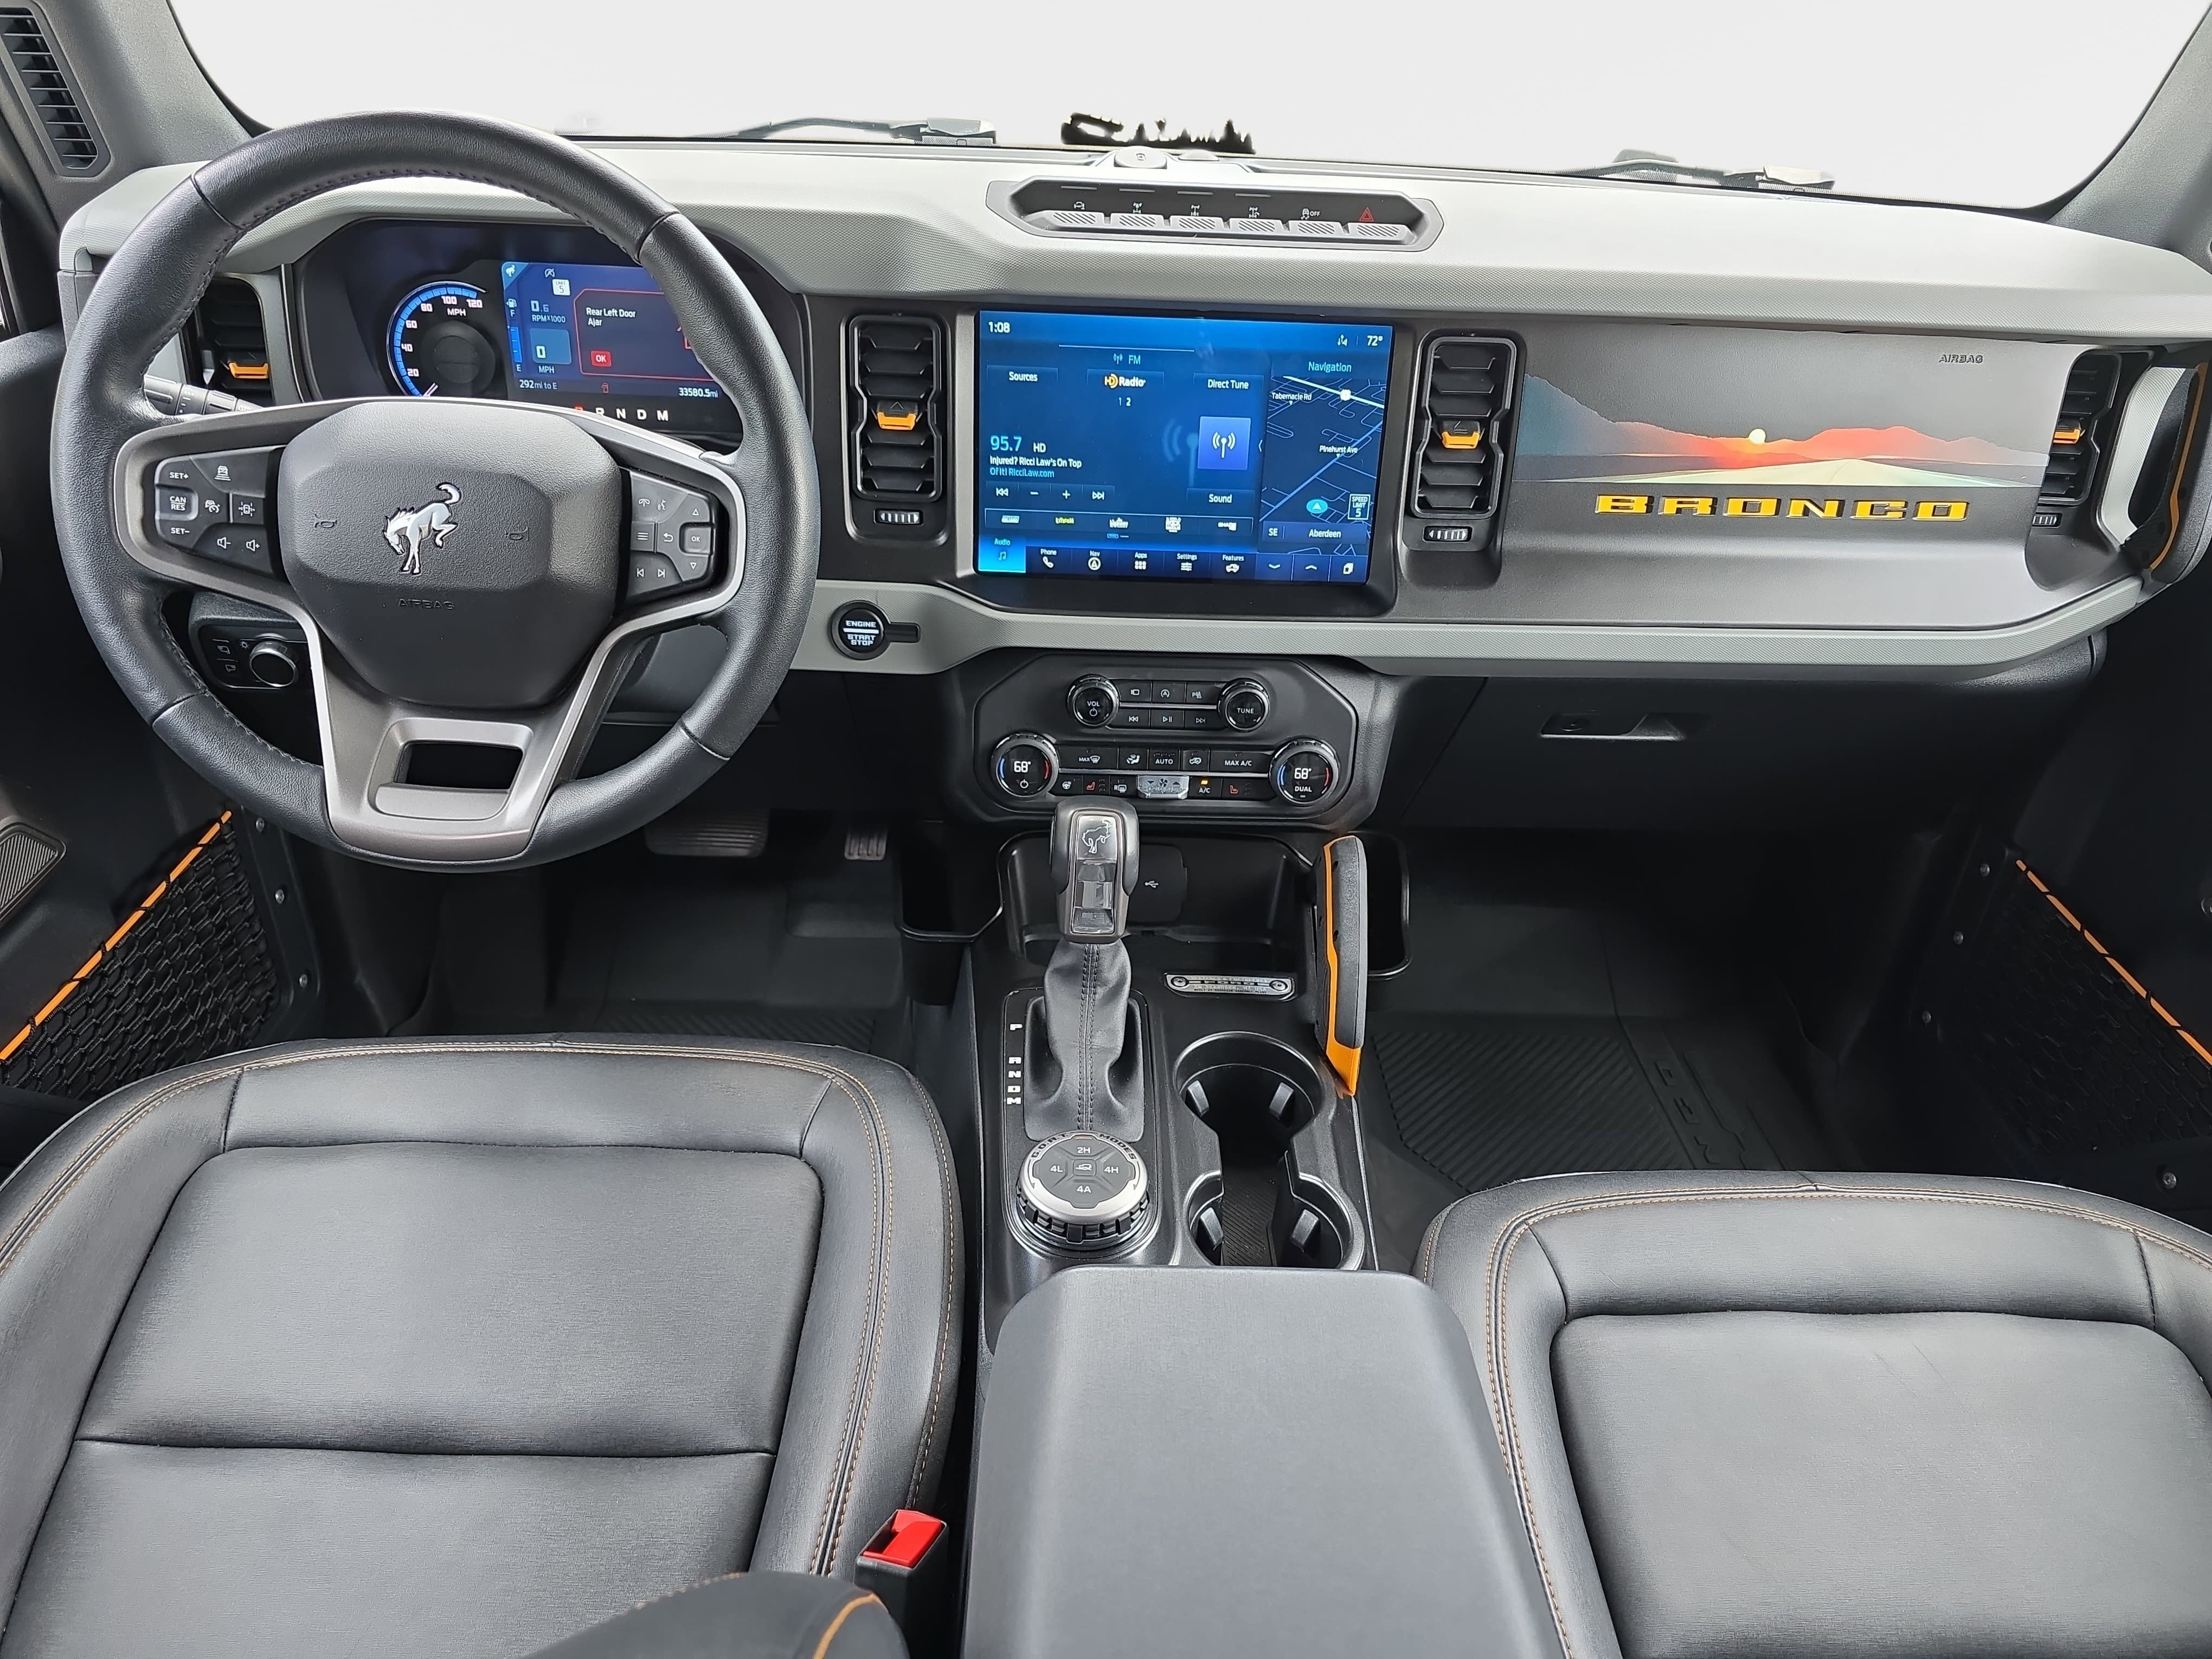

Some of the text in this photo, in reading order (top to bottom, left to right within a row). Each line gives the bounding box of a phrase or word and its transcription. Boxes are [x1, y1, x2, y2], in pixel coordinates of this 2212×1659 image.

[560, 285, 564, 293] 5
[441, 295, 457, 305] 100
[466, 299, 483, 308] 120
[420, 303, 433, 312] 80
[447, 308, 466, 316] MPH
[586, 307, 636, 318] Rear Left Door
[406, 320, 417, 329] 60
[588, 318, 602, 327] Ajar
[988, 321, 1010, 333] 1:08
[401, 343, 413, 352] 40
[536, 345, 546, 358] 0
[596, 355, 607, 363] OK
[1129, 355, 1141, 364] FM
[1938, 354, 1983, 364] AIRBAG
[538, 365, 555, 374] MPH
[1309, 362, 1352, 373] Navigation
[407, 369, 419, 377] 20
[1009, 371, 1038, 382] Sources
[1207, 380, 1249, 389] Direct Tune
[1271, 392, 1303, 400] Tabernacle
[1118, 397, 1131, 406] 1 2
[616, 408, 626, 419] N
[636, 409, 647, 420] D
[657, 410, 668, 421] M
[990, 435, 1022, 451] 95.7
[1033, 442, 1046, 453] HD
[1320, 445, 1345, 453] Pinehurst
[989, 455, 1082, 469] Injured? Ricci Law's On Top
[989, 467, 999, 475] Of
[1008, 468, 1054, 478] RicciLaw.com
[1209, 494, 1232, 503] Sound
[1594, 494, 1969, 521] BRONCO
[1355, 509, 1361, 517] 5
[1269, 528, 1278, 536] SE
[1309, 529, 1341, 538] Aberdeen
[398, 599, 455, 610] AIRBAG
[1099, 1134, 1137, 1160] MODES
